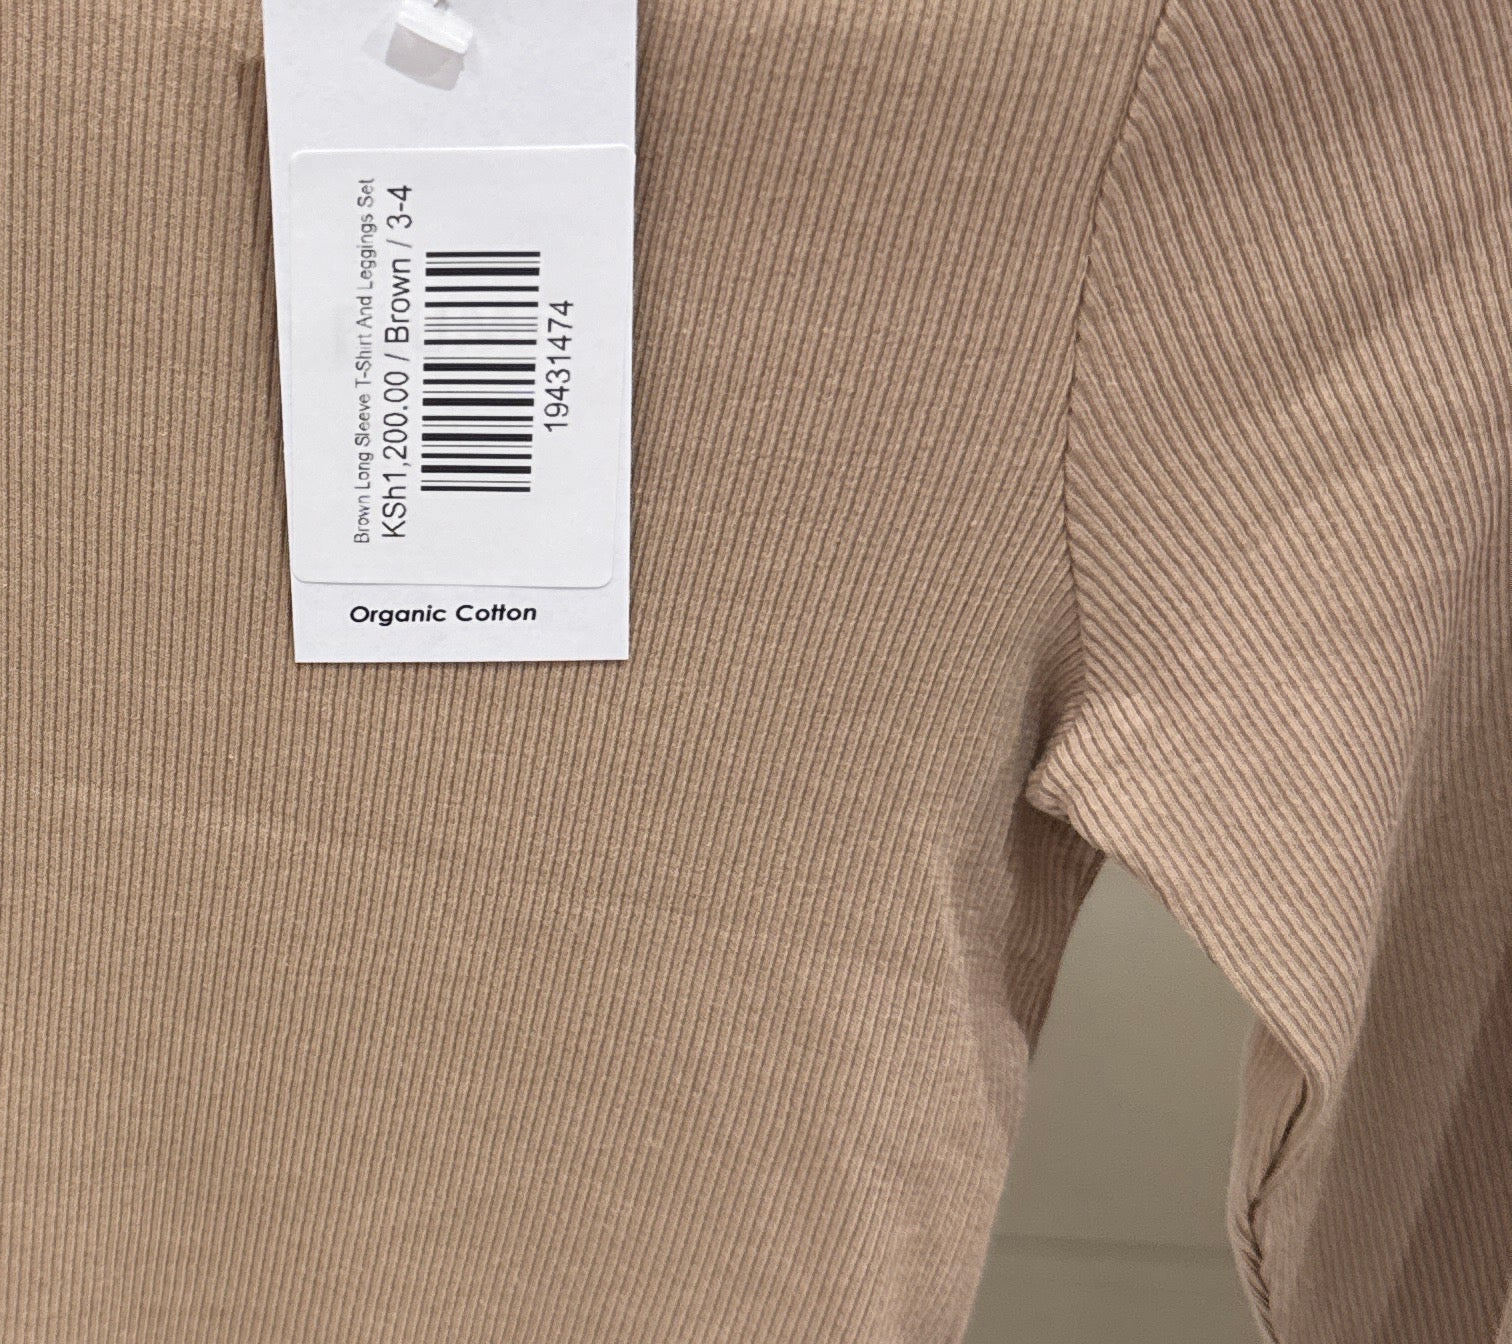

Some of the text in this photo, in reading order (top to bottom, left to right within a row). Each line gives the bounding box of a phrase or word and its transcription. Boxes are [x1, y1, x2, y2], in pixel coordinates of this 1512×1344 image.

[353, 177, 378, 544] Brown Long Sleeve T-Shirt And Leggings Set
[381, 184, 413, 538] KSh1,200.00 / Brown / 3-4
[543, 300, 574, 433] 19431474
[349, 603, 537, 627] Organic Cotton
